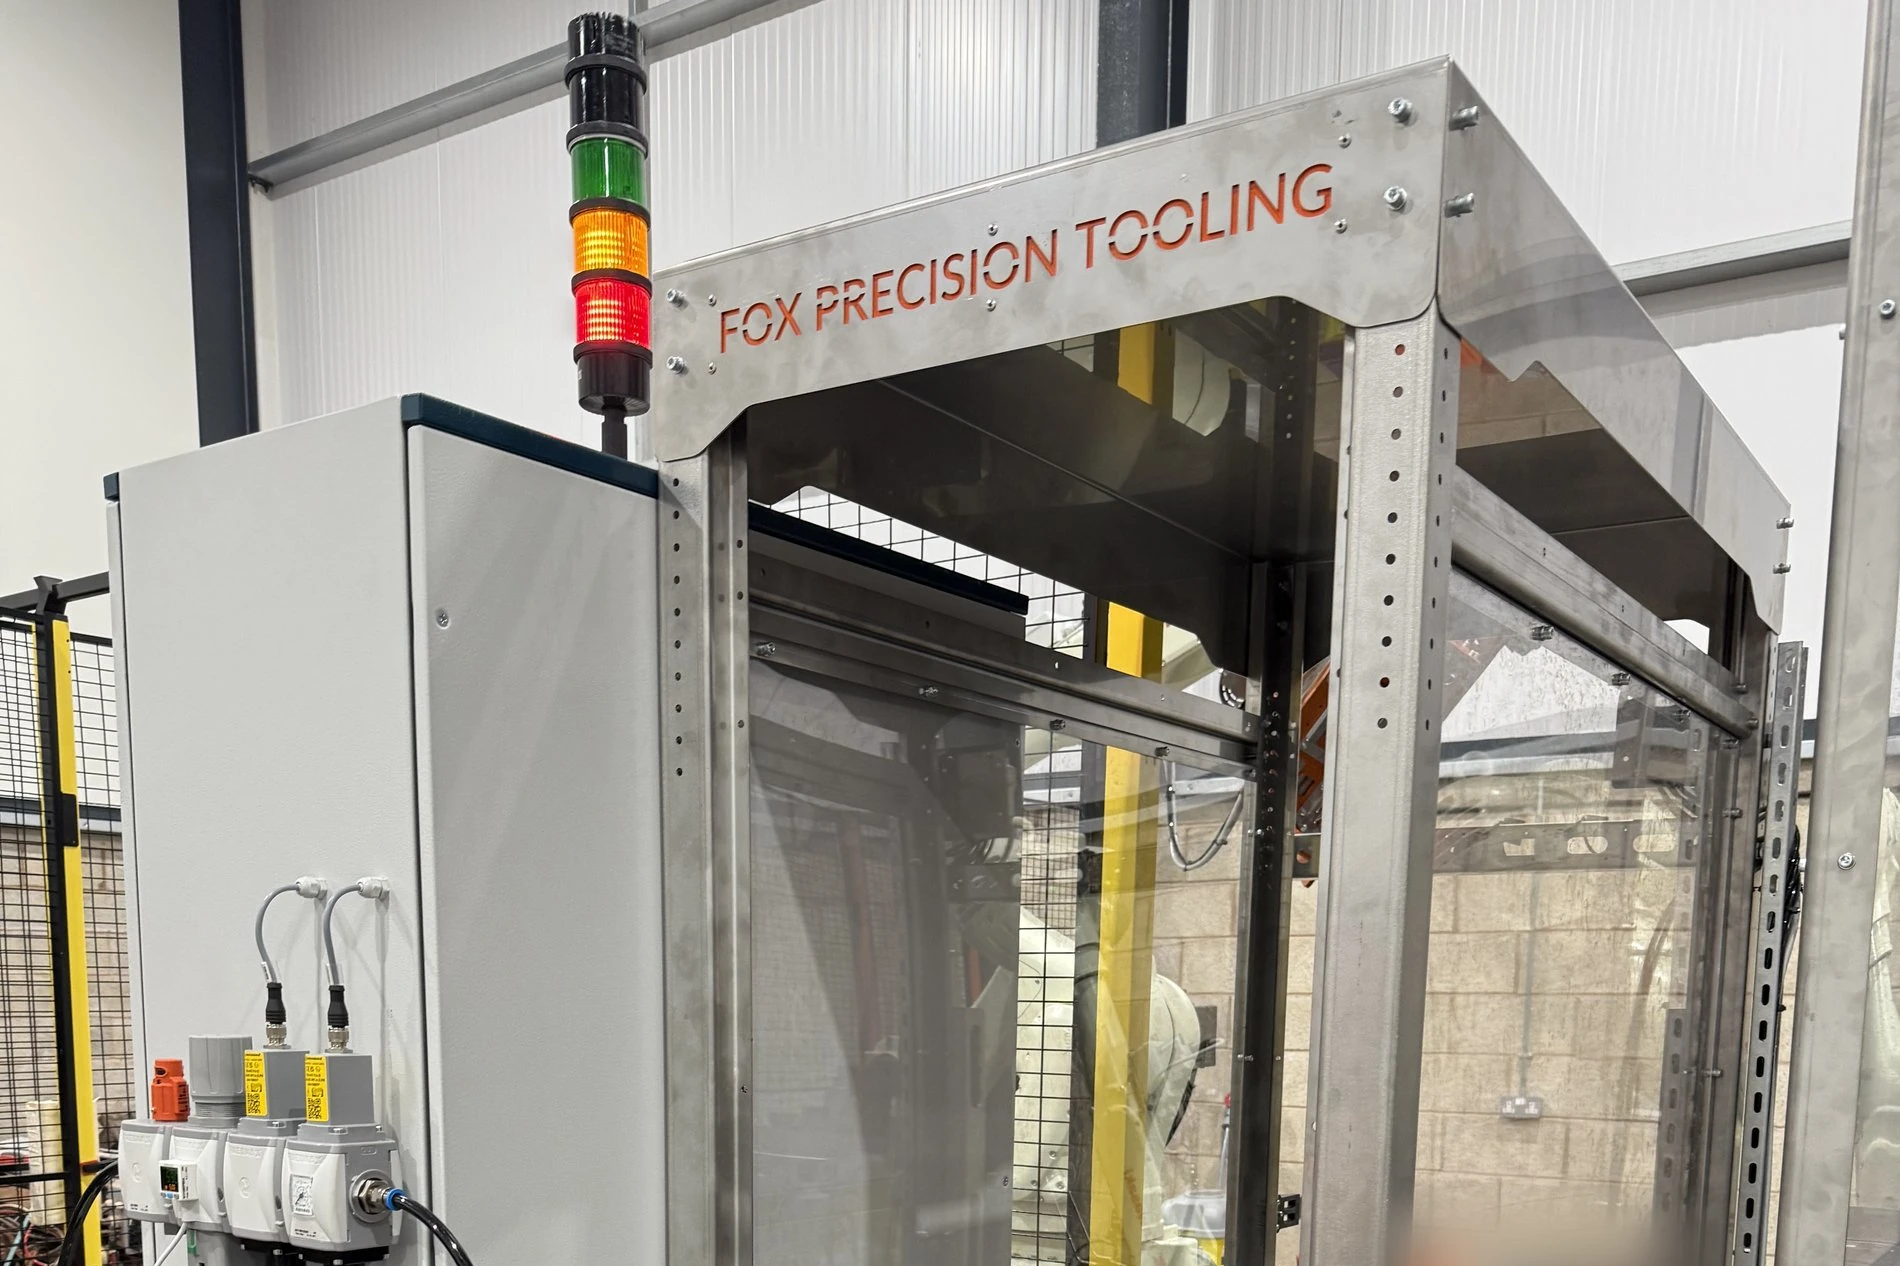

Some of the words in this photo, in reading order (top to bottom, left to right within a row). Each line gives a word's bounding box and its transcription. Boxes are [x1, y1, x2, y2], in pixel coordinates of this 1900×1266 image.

[720, 292, 802, 353] FOX
[816, 229, 1058, 331] PRECISION
[1075, 163, 1333, 269] TOOLING
